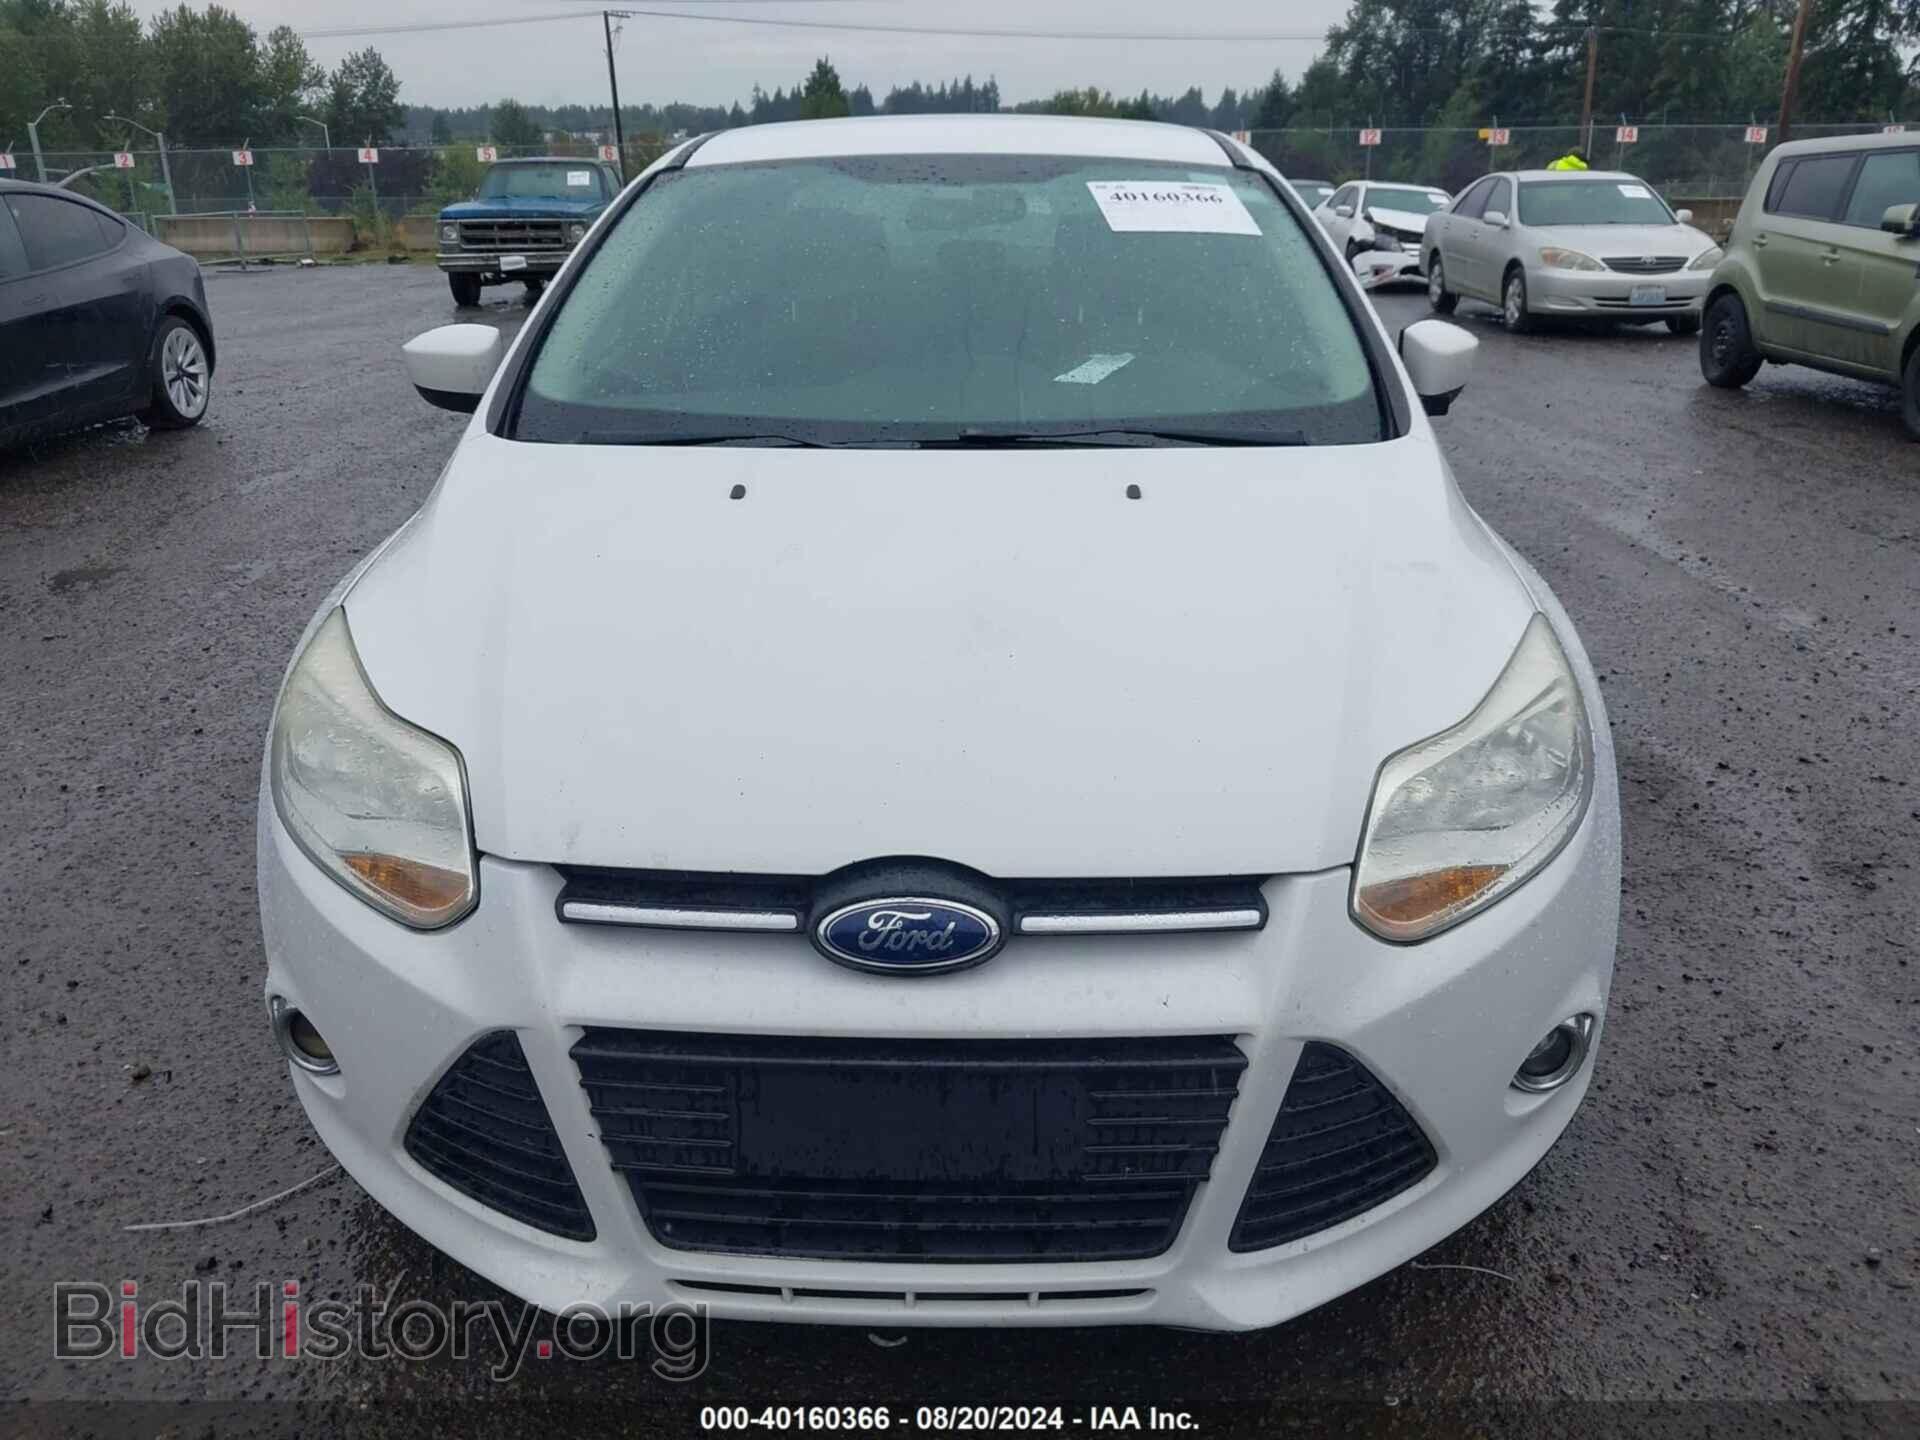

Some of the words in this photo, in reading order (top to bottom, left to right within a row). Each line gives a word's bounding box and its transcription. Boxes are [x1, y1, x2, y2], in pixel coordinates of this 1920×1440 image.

[1365, 130, 1377, 143] 12
[1494, 130, 1506, 143] 13
[1622, 128, 1634, 141] 14
[1751, 128, 1763, 141] 15
[121, 154, 128, 166] 2
[239, 153, 247, 164] 3
[363, 149, 372, 161] 4
[484, 148, 491, 160] 5
[604, 147, 611, 160] 6
[1109, 190, 1223, 204] 40160366
[857, 910, 956, 951] Ford
